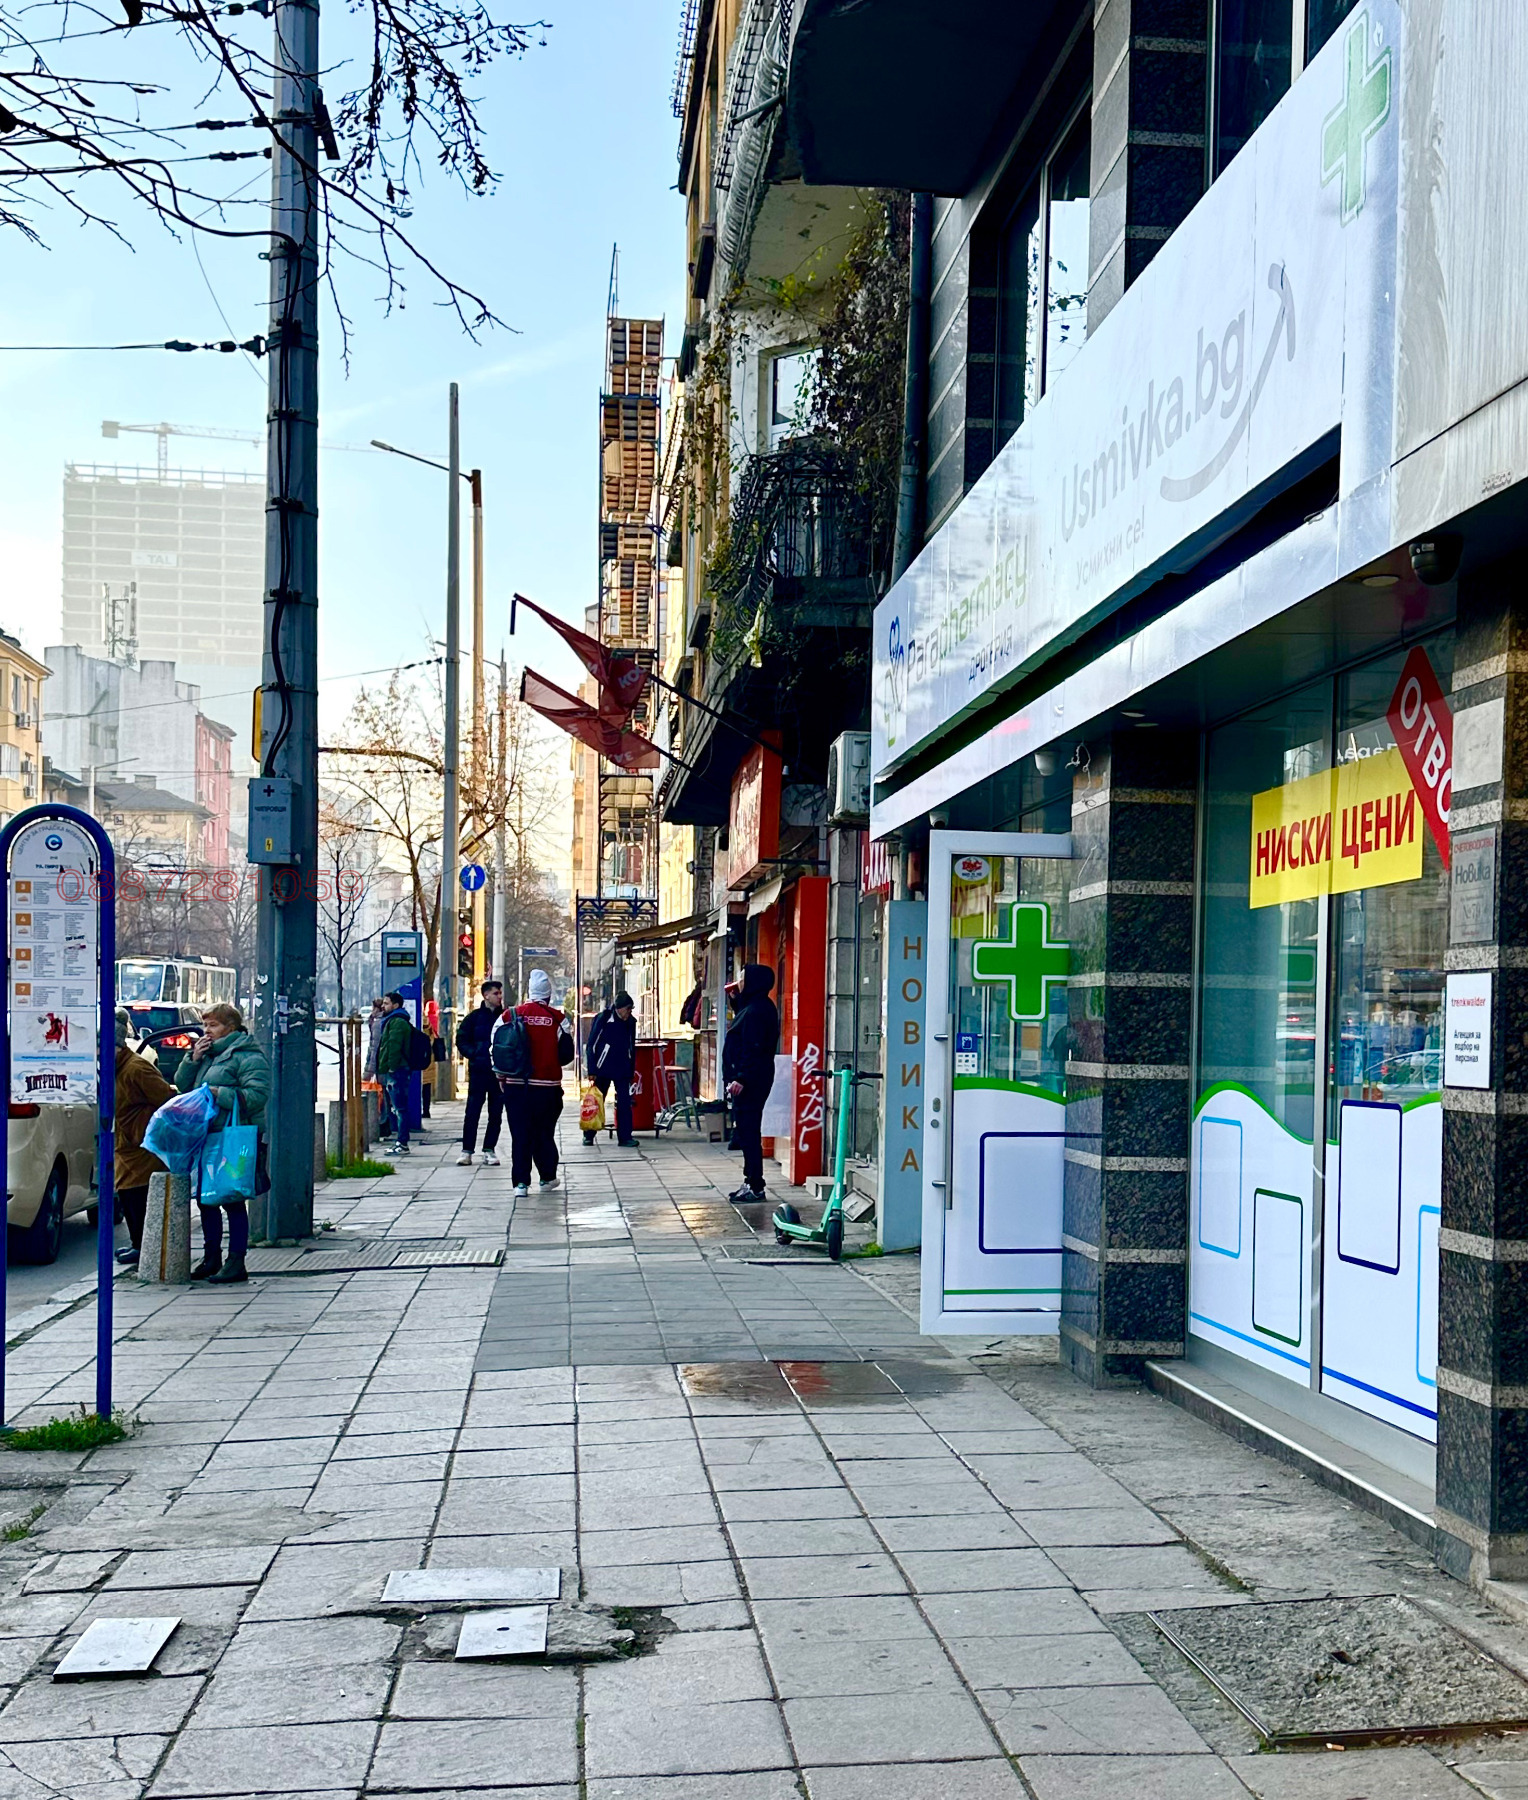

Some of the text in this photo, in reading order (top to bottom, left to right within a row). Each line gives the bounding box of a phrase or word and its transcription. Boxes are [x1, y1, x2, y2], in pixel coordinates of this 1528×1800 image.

[1061, 309, 1246, 543] Usmivka.bg
[1076, 504, 1145, 591] Усмихни се!
[968, 624, 1013, 685] ДРОГЕРИЯ
[1400, 676, 1452, 824] ОТВО
[1256, 790, 1415, 877] НИСКИ ЦЕНИ
[1451, 996, 1486, 1007] trenkwalder
[900, 936, 923, 1172] НОВИКА
[1454, 1041, 1480, 1053] подбор на
[1455, 1054, 1479, 1064] персонал
